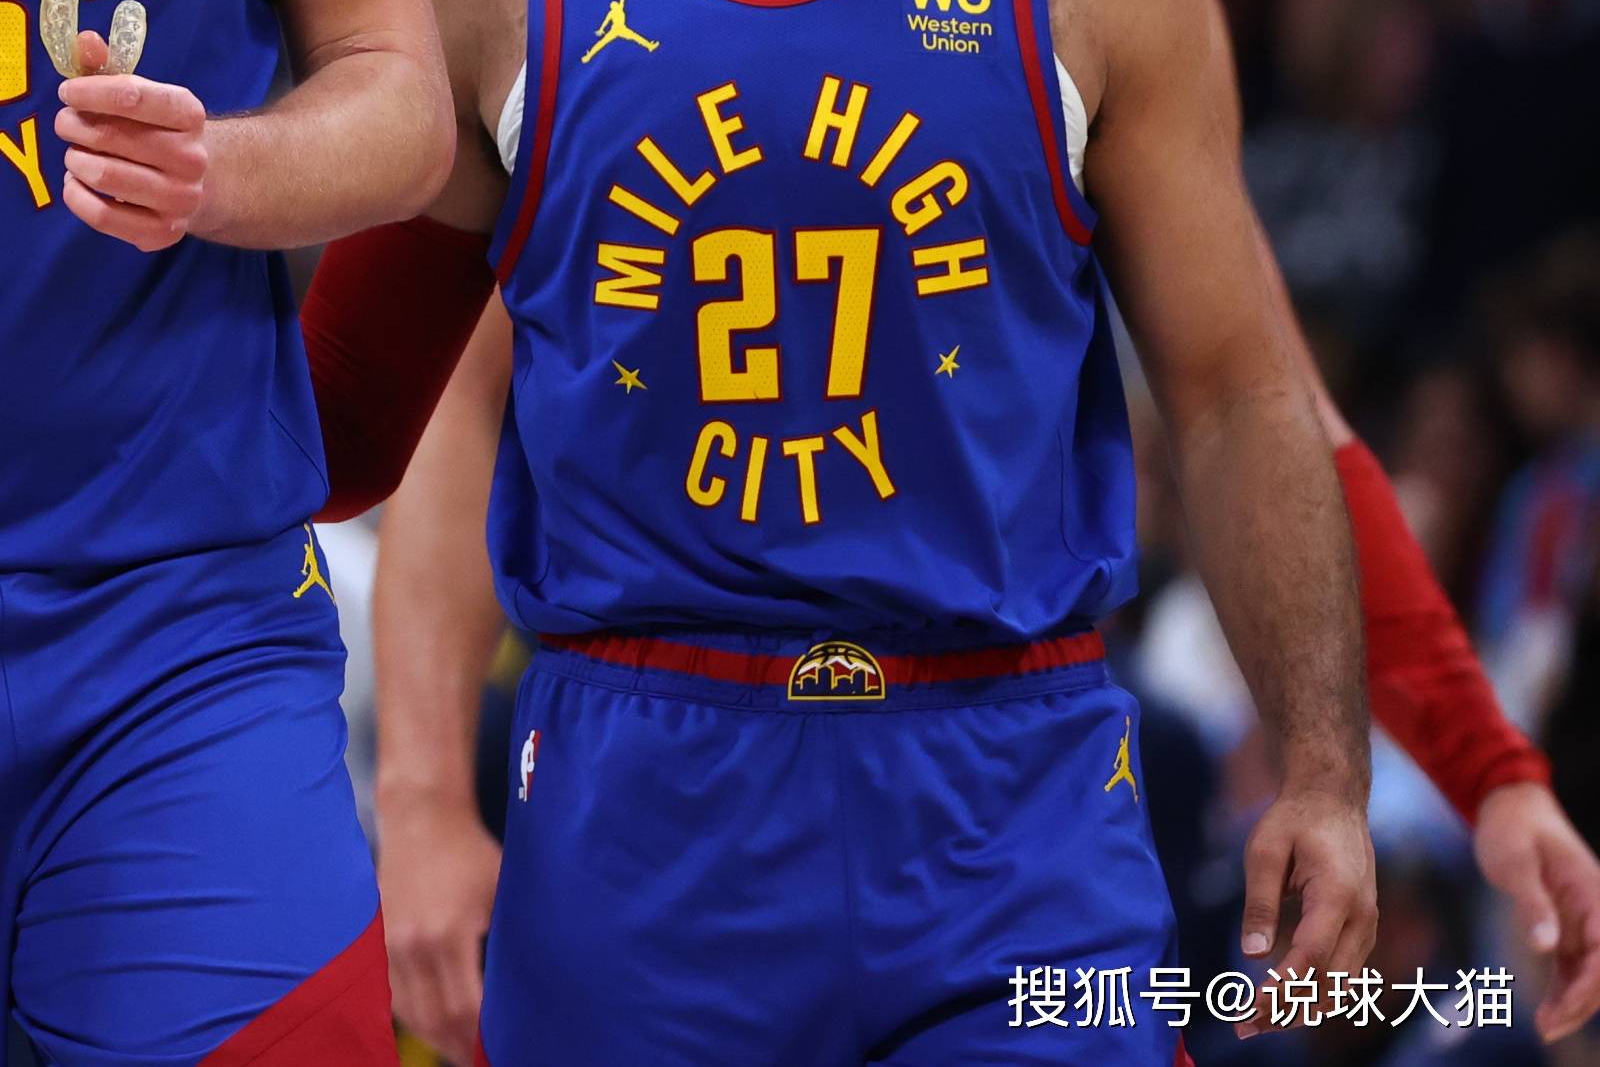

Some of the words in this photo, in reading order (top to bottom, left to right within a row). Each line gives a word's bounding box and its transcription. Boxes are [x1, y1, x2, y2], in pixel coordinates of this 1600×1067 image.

[907, 13, 993, 37] Western
[922, 32, 980, 54] Union
[593, 81, 763, 311] MILE
[802, 74, 990, 297] HIGH
[691, 227, 881, 403] 27
[685, 409, 896, 526] CITY
